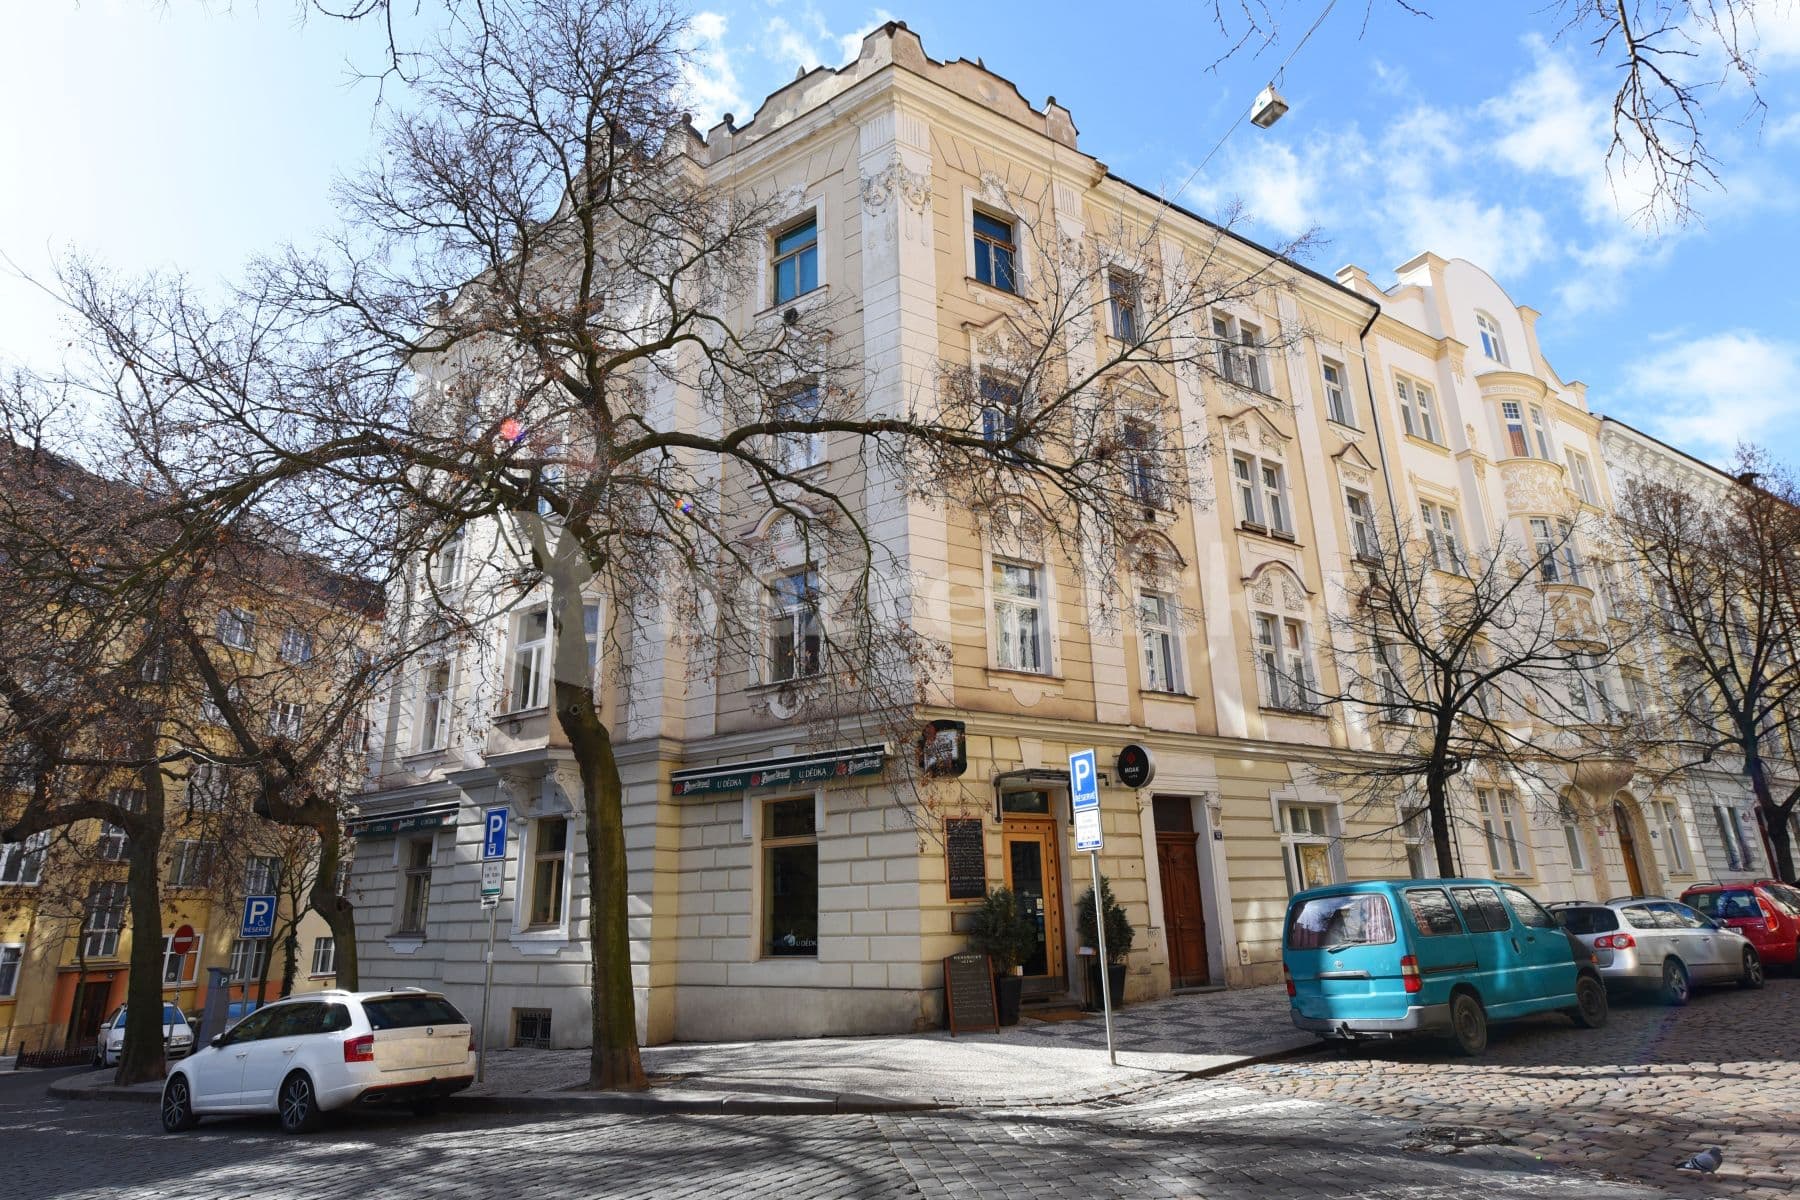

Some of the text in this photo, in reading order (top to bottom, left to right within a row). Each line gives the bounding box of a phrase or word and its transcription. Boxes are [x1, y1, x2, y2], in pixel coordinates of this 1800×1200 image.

[1075, 759, 1090, 791] P
[489, 815, 503, 843] P
[249, 901, 269, 925] P
[220, 977, 228, 987] P
